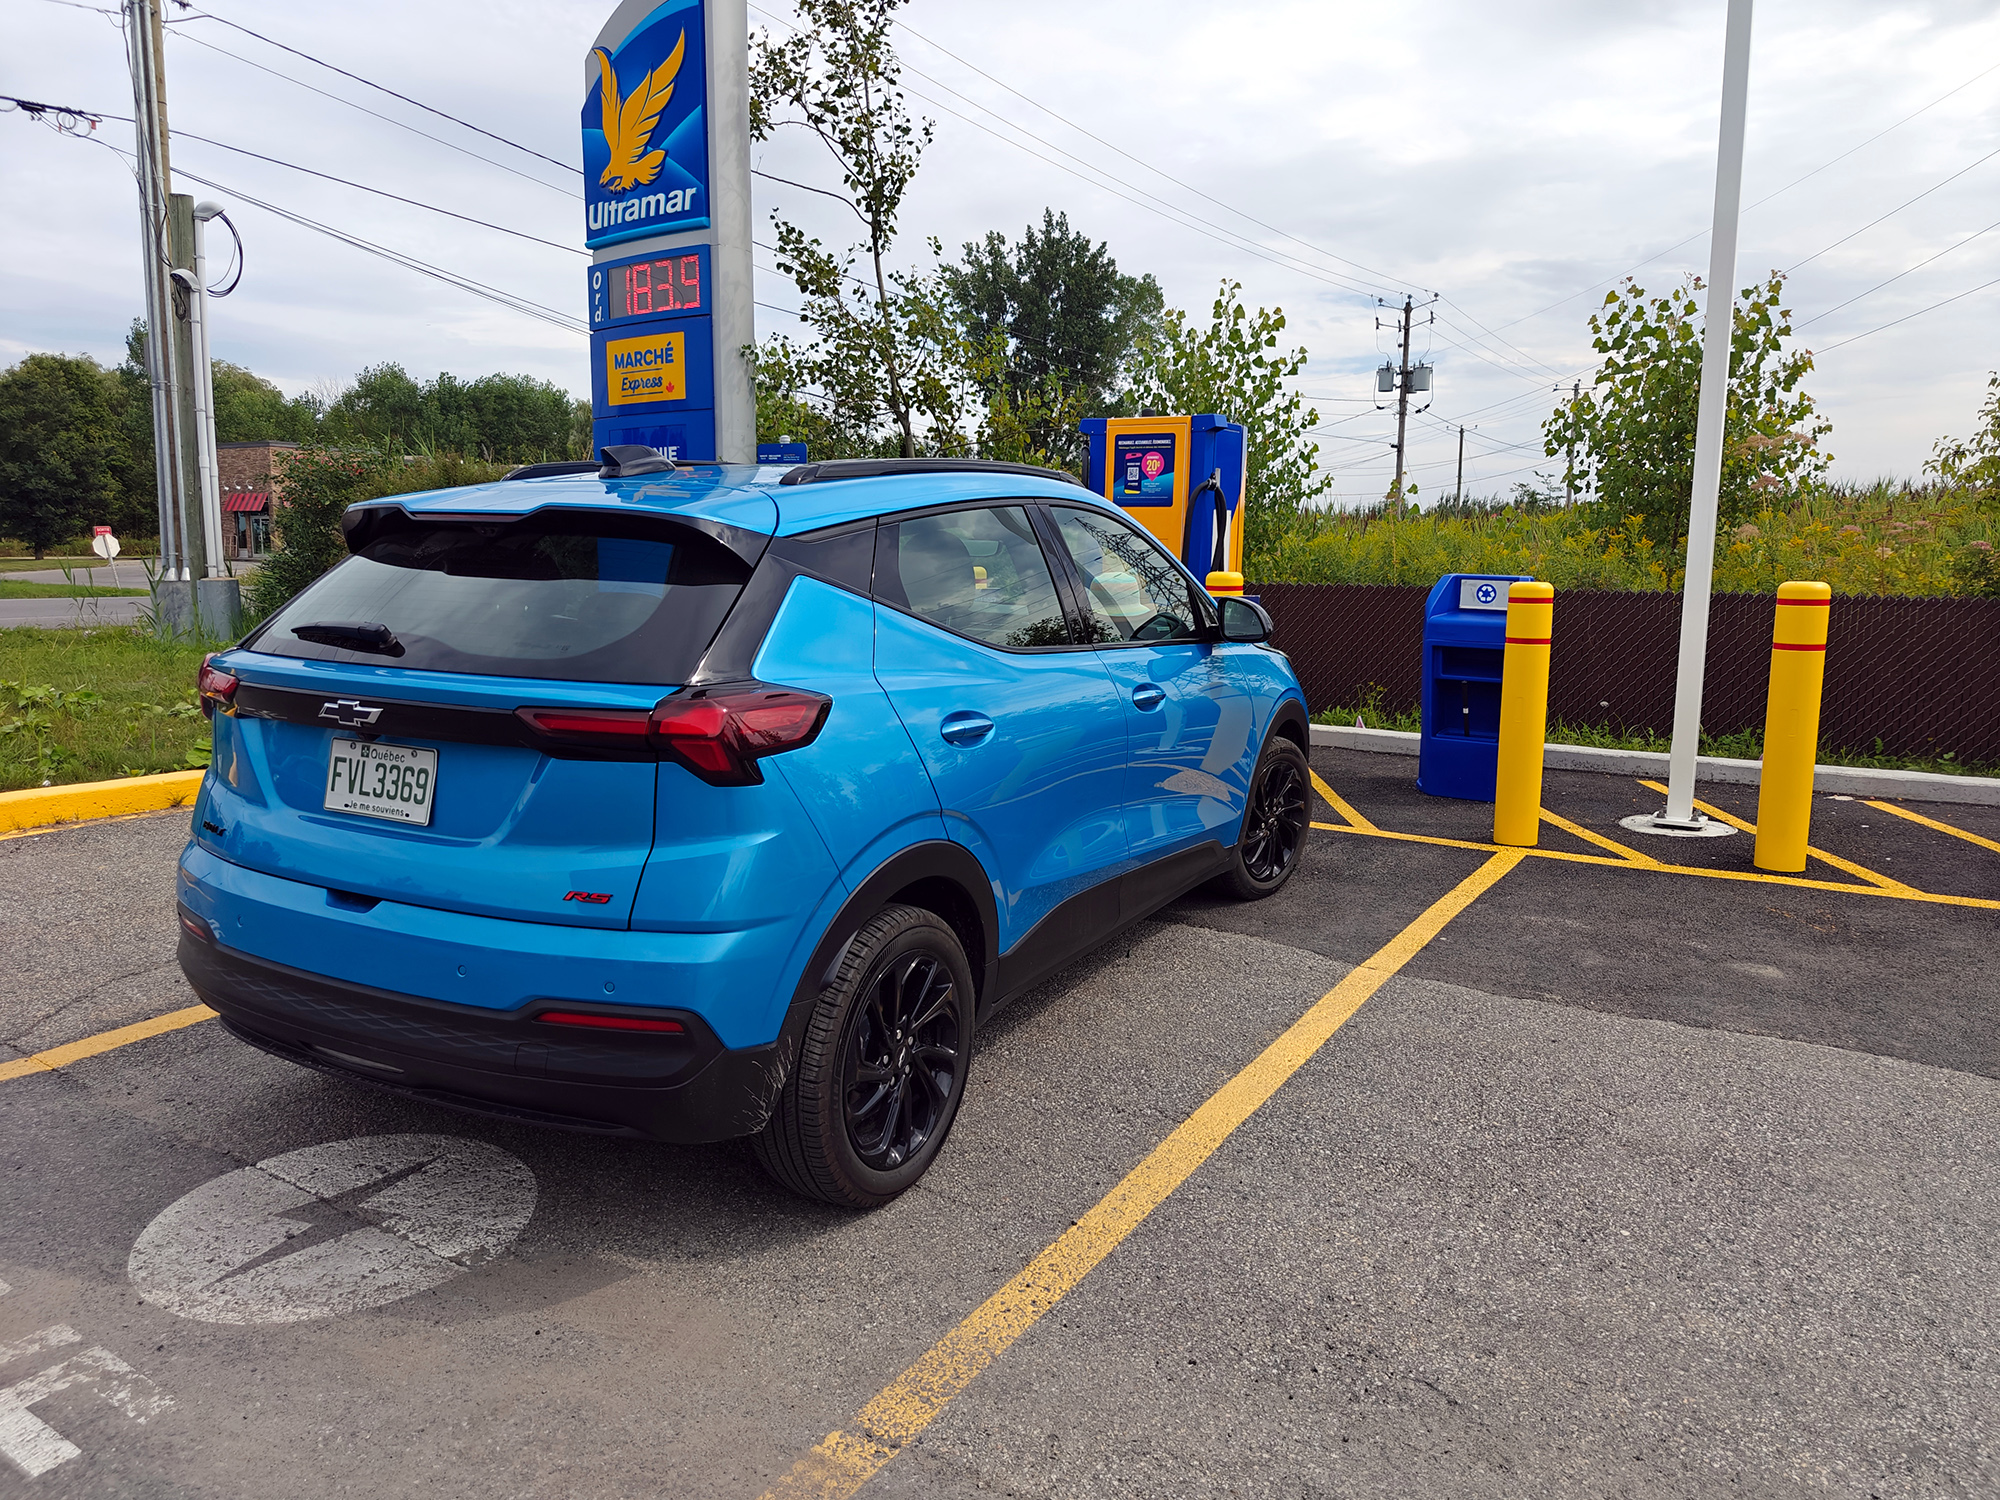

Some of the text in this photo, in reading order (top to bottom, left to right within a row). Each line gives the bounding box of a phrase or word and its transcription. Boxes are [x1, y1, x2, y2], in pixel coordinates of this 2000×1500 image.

[588, 187, 697, 231] Ultramar
[625, 255, 701, 316] 183.9
[614, 340, 674, 370] MARCHÉ
[621, 376, 663, 394] Express
[370, 748, 406, 763] Québec
[330, 756, 430, 805] FVL3369
[348, 800, 405, 817] Je me souviens
[562, 890, 614, 905] RS
